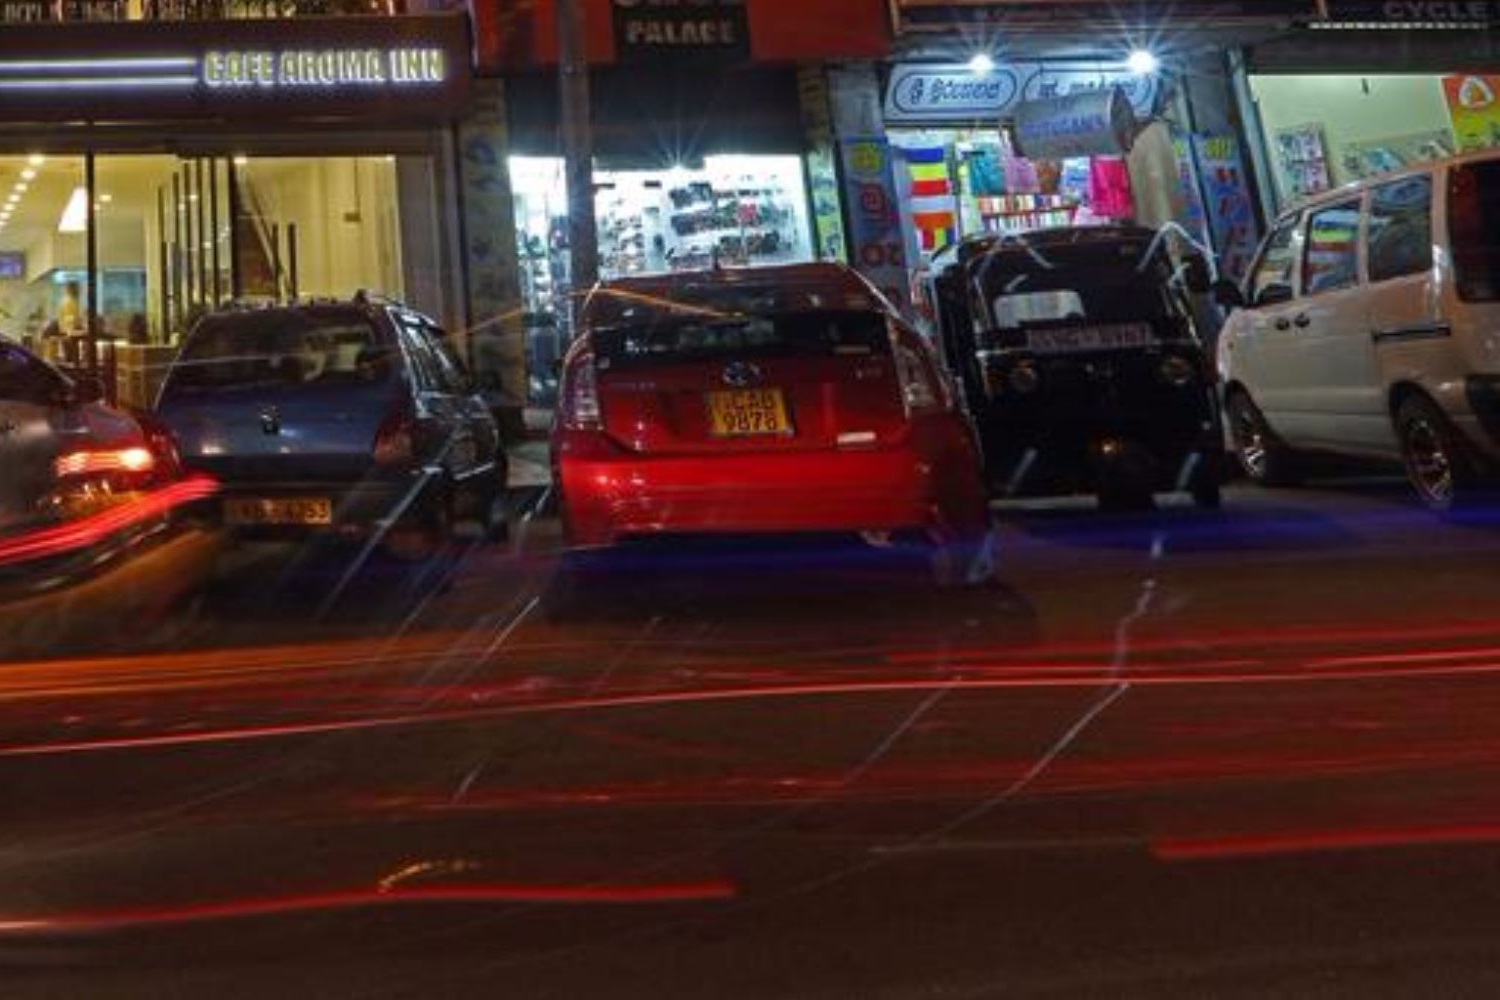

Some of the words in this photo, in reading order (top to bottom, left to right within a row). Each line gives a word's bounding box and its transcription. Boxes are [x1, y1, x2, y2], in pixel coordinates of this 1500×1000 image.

[1382, 0, 1488, 20] CYCLE
[628, 18, 737, 45] PALACE
[203, 51, 274, 86] CAFE
[280, 50, 386, 84] AROMA
[389, 48, 444, 82] INN
